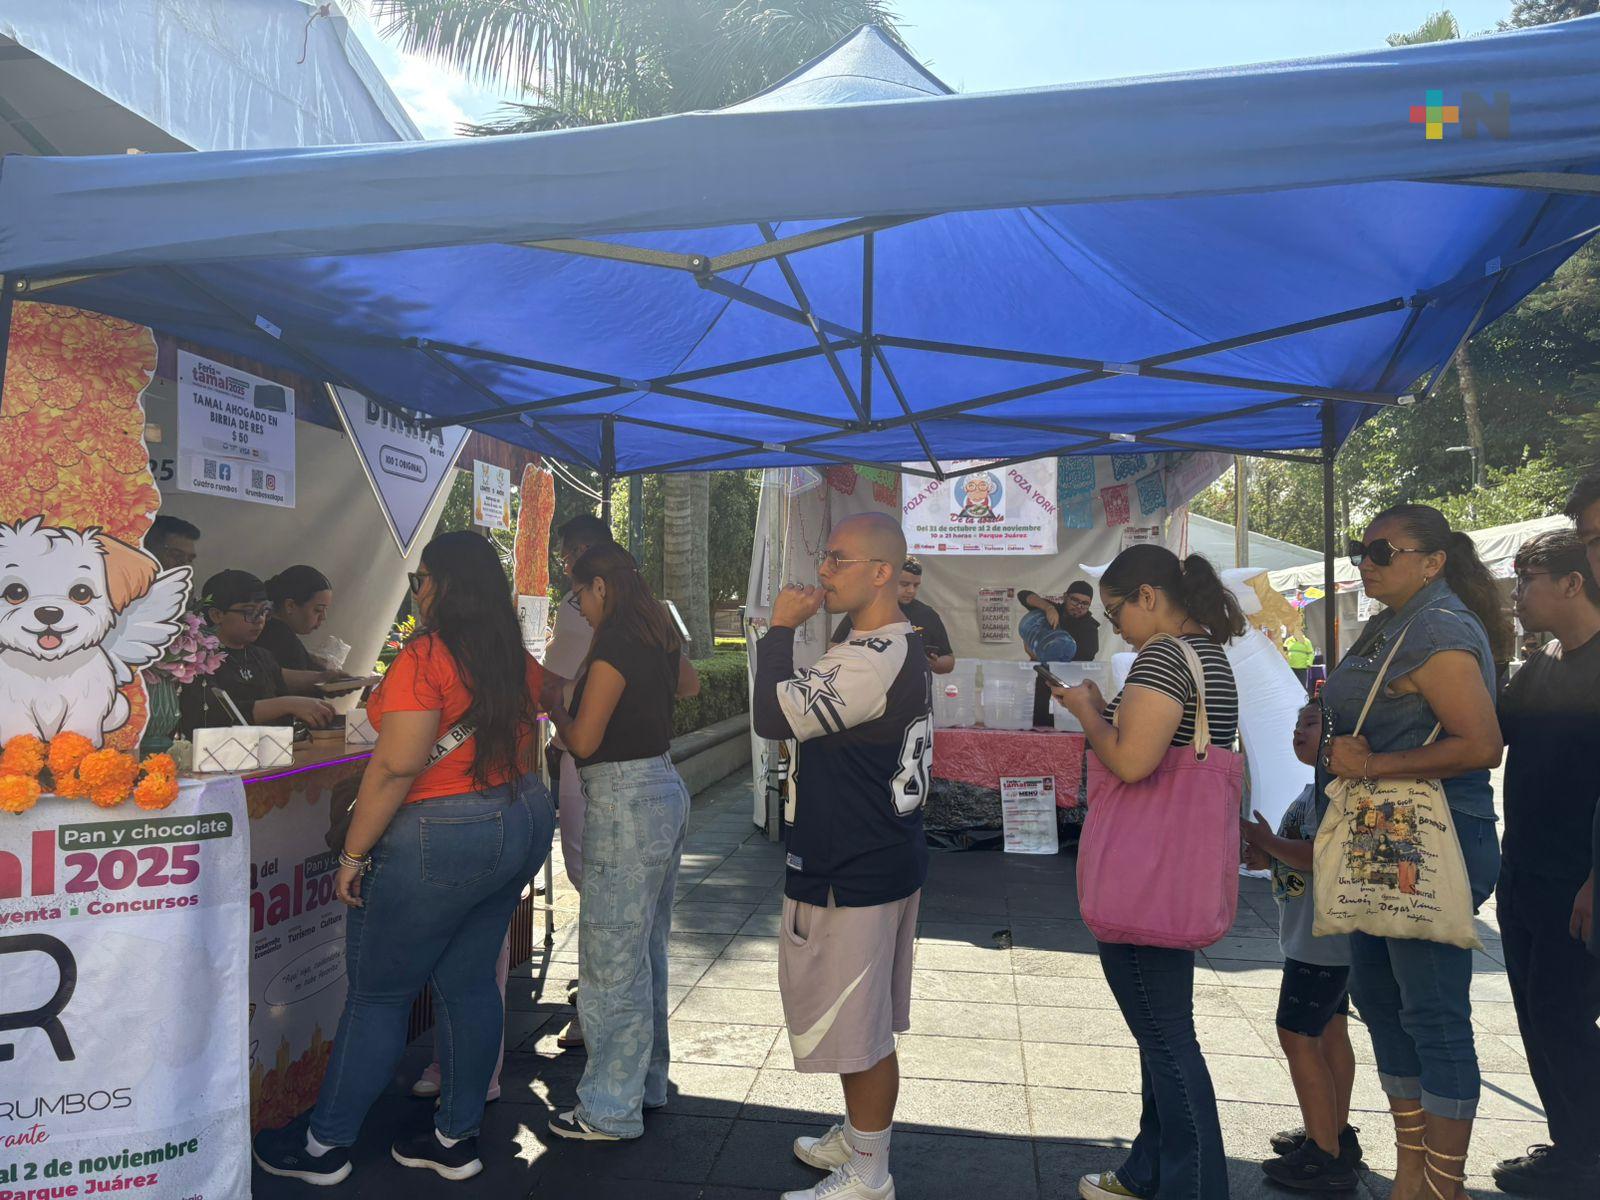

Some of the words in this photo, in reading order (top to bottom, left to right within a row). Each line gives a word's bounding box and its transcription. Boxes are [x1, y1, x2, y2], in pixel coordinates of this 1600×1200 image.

[192, 367, 229, 391] tamal
[193, 392, 223, 411] TAMAL
[225, 402, 267, 424] AHOGADO
[268, 414, 278, 427] EN
[210, 411, 237, 428] BIRRIA
[239, 420, 249, 432] DE
[251, 423, 264, 435] RES
[238, 433, 249, 444] 50
[215, 481, 238, 494] rumbos
[1008, 468, 1032, 495] POZA
[1031, 490, 1057, 515] YORK
[903, 493, 928, 515] POZA
[916, 524, 928, 532] Del
[938, 524, 947, 532] de
[948, 524, 976, 532] octubre
[992, 524, 1001, 532] de
[1002, 524, 1041, 532] noviembre
[65, 829, 106, 845] Pan
[112, 829, 125, 844] y
[131, 819, 228, 840] chocolate
[64, 843, 200, 894] 2025
[261, 858, 279, 878] del
[306, 860, 323, 874] Pan
[0, 906, 62, 925] venta
[87, 894, 199, 916] Concursos
[288, 925, 316, 943] Turismo
[320, 914, 342, 929] Cultura
[0, 1087, 132, 1121] RUMBOS
[0, 1163, 18, 1184] al
[23, 1162, 38, 1181] 2
[43, 1158, 73, 1178] de
[79, 1137, 199, 1174] noviembre
[84, 1172, 159, 1195] Juárez
